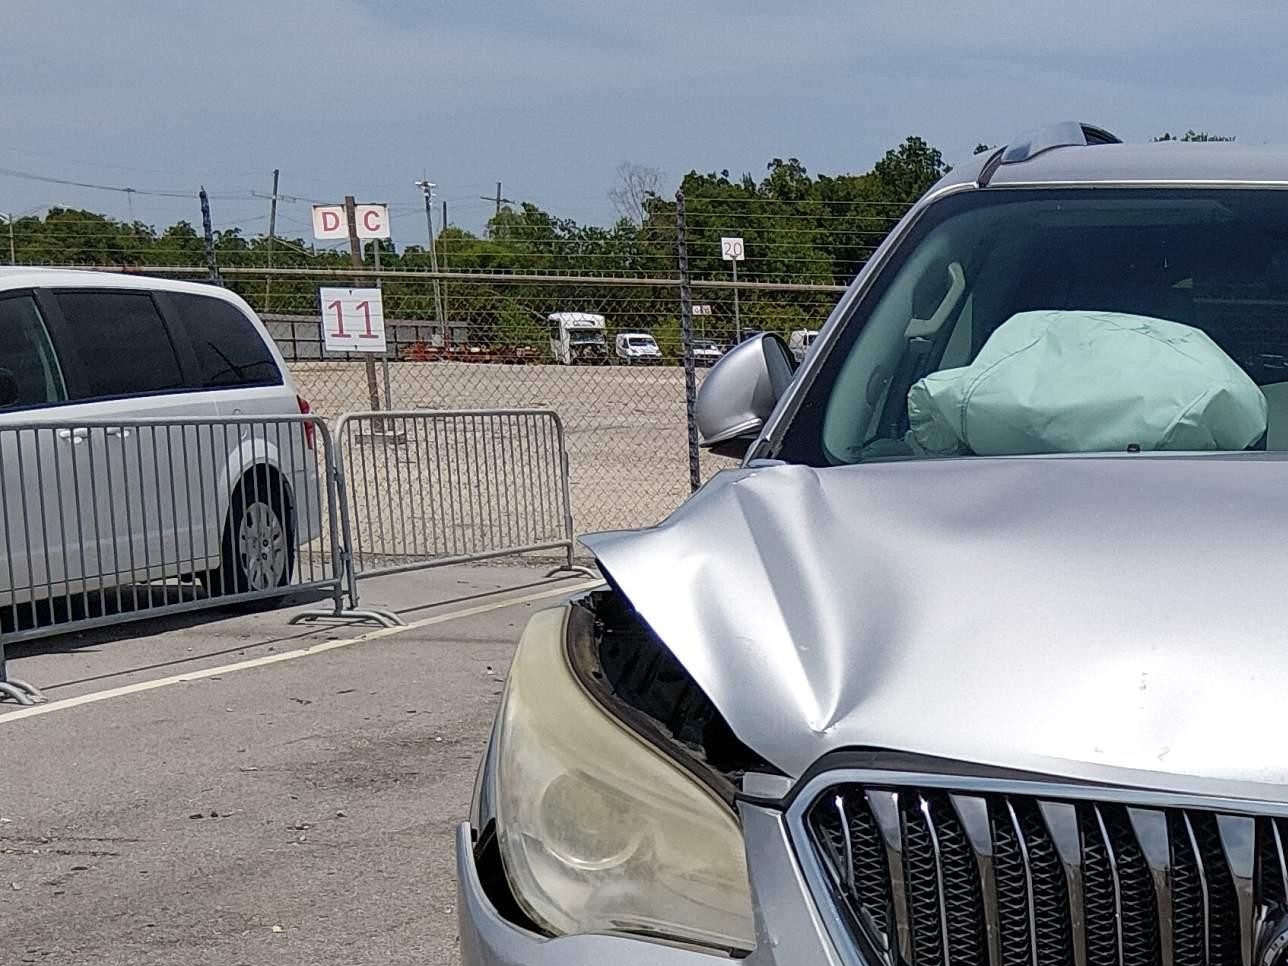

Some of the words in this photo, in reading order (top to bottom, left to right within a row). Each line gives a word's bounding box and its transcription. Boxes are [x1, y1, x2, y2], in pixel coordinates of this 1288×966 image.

[321, 211, 340, 232] D
[363, 210, 381, 232] C
[723, 242, 743, 256] 20
[328, 300, 379, 339] 11
